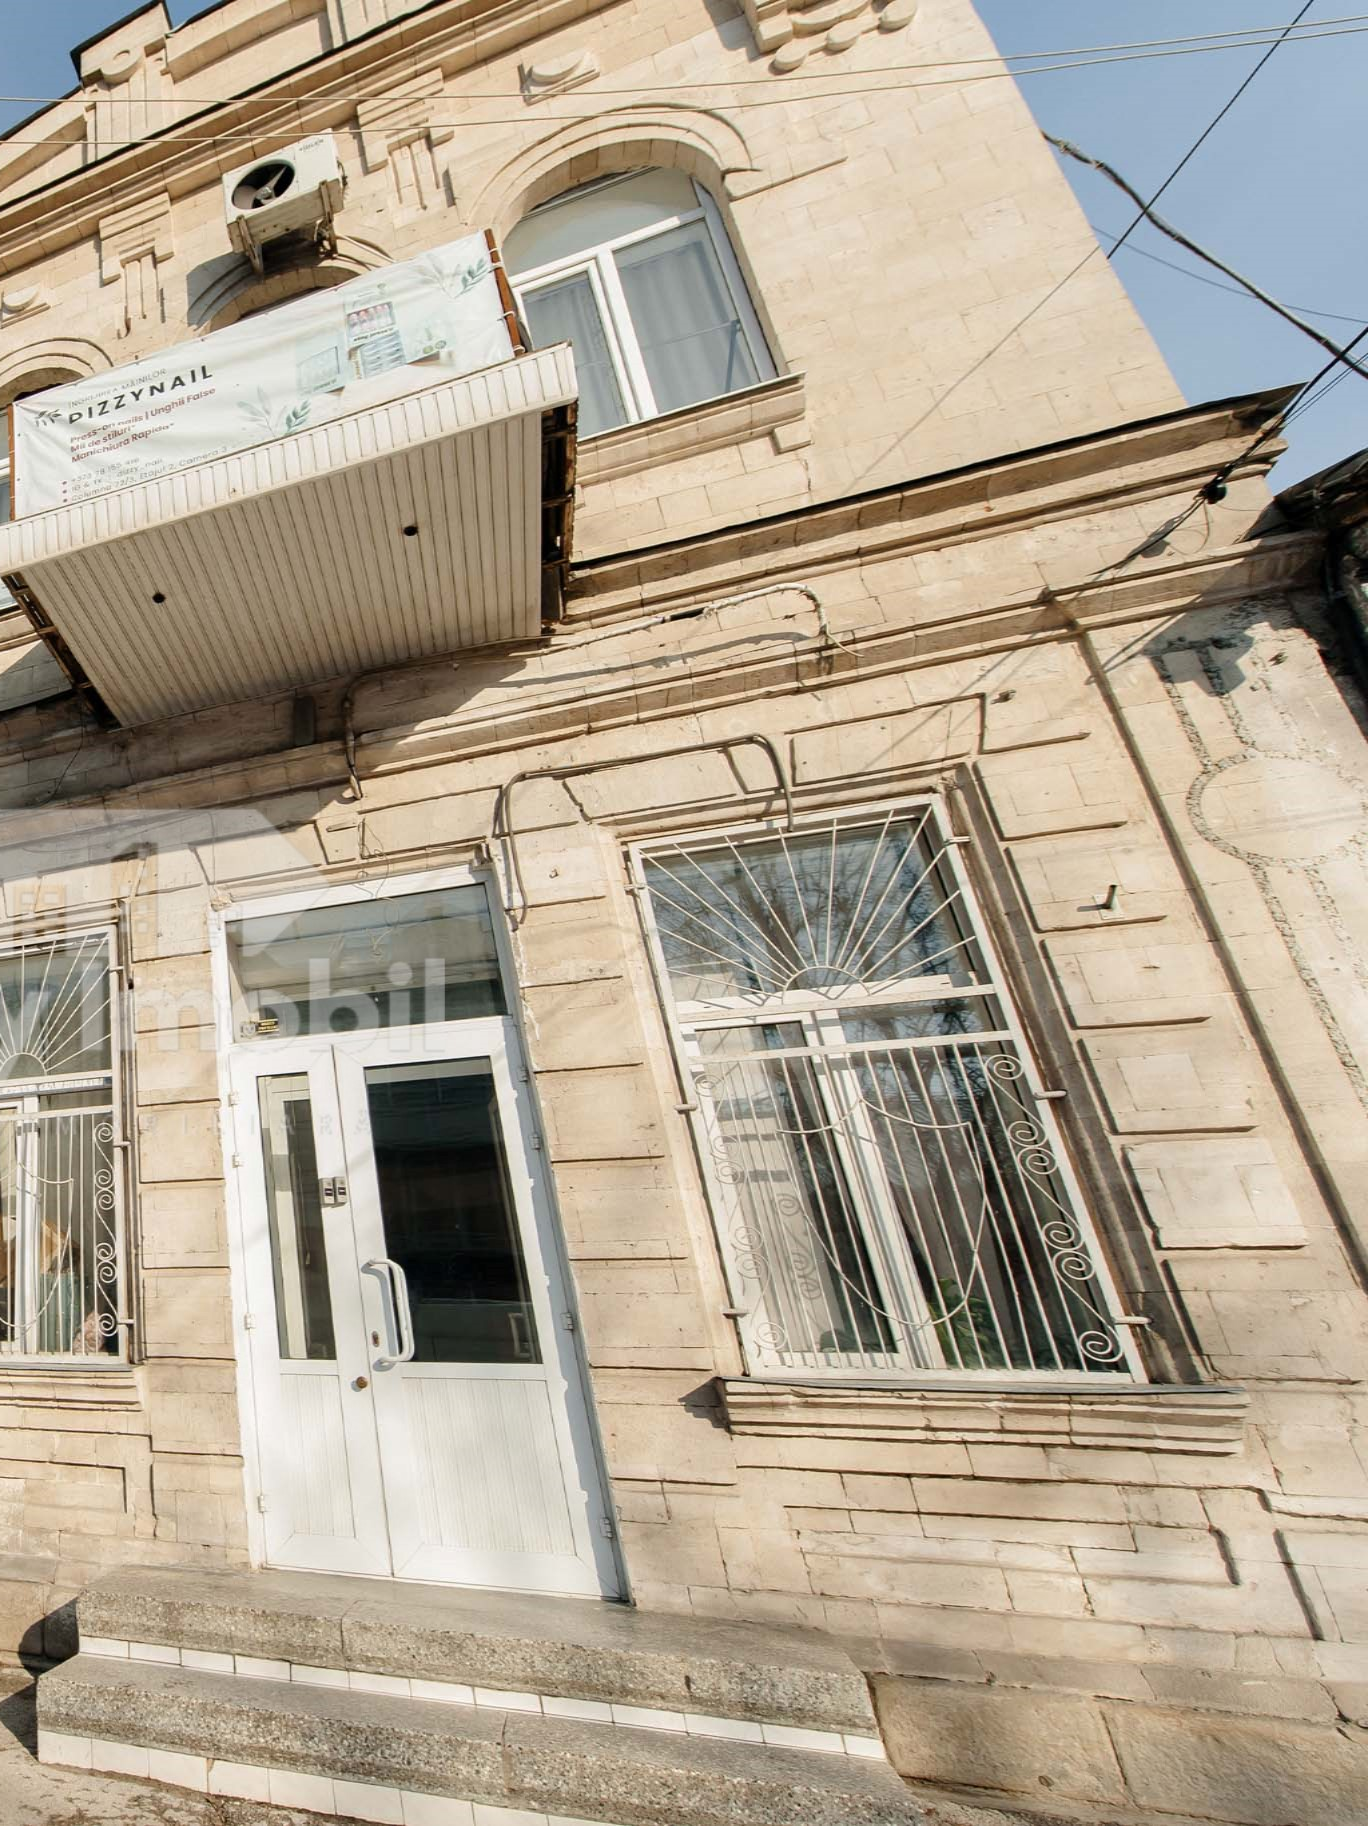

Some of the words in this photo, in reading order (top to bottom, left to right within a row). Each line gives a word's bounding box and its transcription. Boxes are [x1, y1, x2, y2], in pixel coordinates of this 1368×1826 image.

[68, 365, 213, 424] DIZZYNAIL
[70, 423, 115, 443] Press-on
[150, 397, 185, 417] Unghii
[186, 388, 216, 403] False
[87, 439, 101, 448] de
